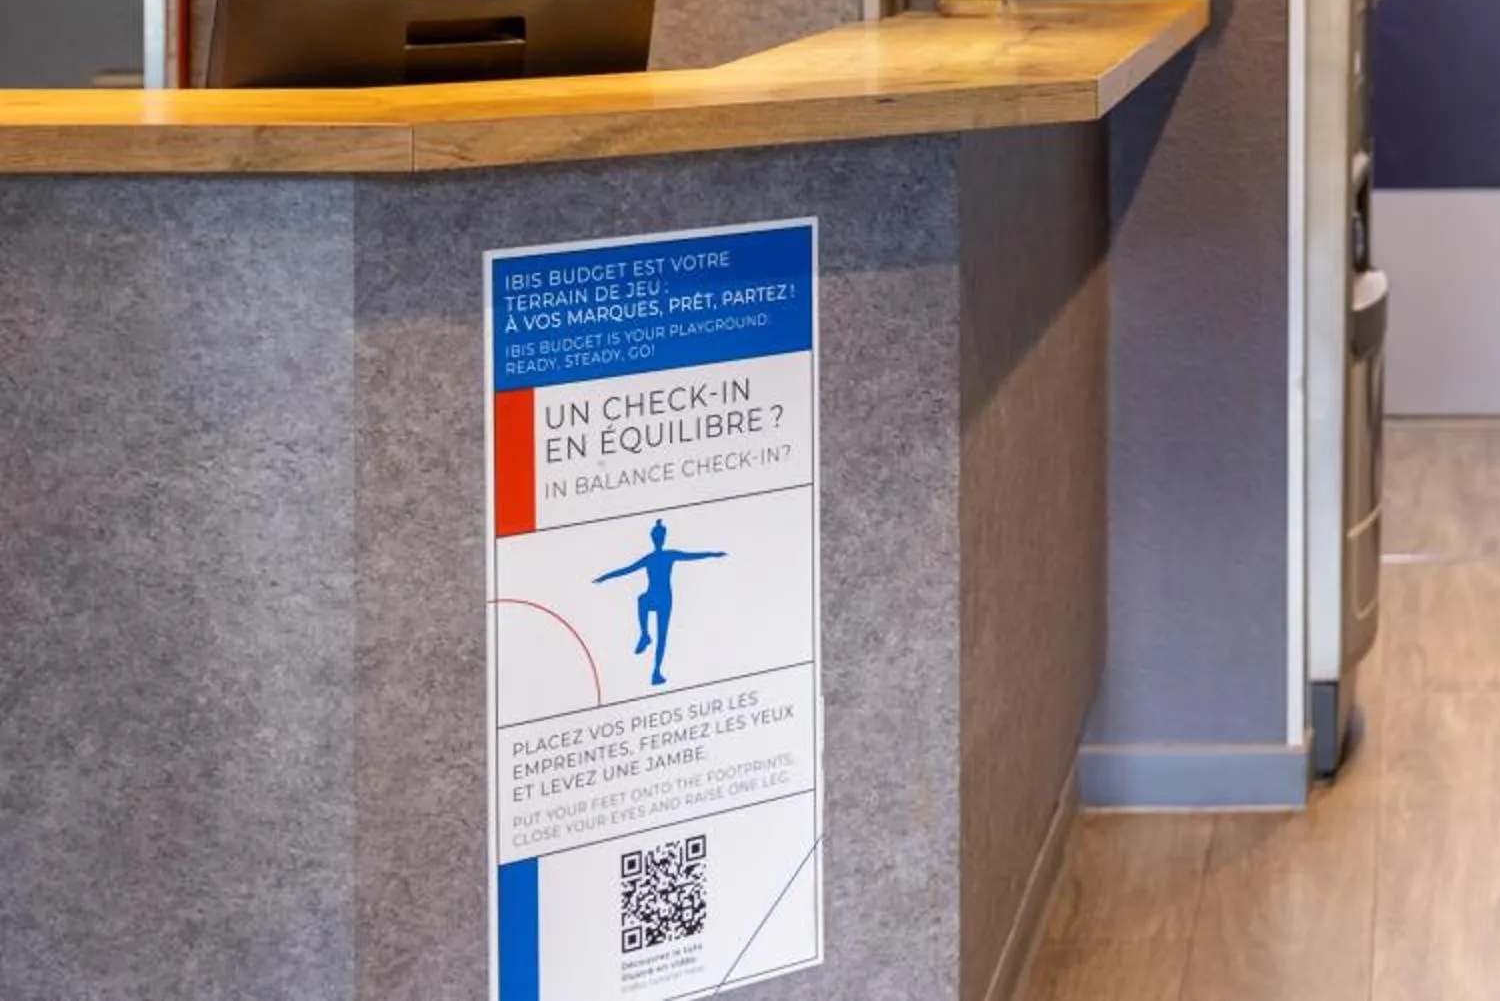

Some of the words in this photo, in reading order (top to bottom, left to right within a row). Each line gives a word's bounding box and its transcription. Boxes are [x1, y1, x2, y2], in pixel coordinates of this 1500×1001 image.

[505, 272, 542, 291] IBIS
[549, 262, 626, 286] BUDGET
[633, 258, 664, 277] EST
[671, 250, 730, 271] VOTRE
[504, 288, 588, 312] TERRAIN
[595, 284, 620, 301] DE
[505, 314, 519, 334] À
[523, 311, 562, 330] VOS
[567, 299, 663, 326] MARQUES,
[669, 290, 717, 313] PRÊT,
[505, 342, 536, 359] IBIS
[540, 334, 601, 354] BUDGET
[607, 331, 620, 345] IS
[624, 325, 666, 343] YOUR
[628, 343, 656, 359] GO!
[545, 399, 590, 430] UN
[602, 377, 751, 422] CHECK-IN
[546, 434, 587, 464] EN
[545, 481, 567, 500] IN
[575, 461, 675, 495] BALANCE
[681, 443, 793, 479] CHECK-IN?
[512, 728, 584, 758] PLACEZ
[588, 720, 625, 740] VOS
[631, 707, 683, 732] PIEDS
[687, 699, 723, 720] SUR
[728, 690, 759, 710] LES
[640, 722, 711, 751] FERMEZ
[715, 714, 748, 735] LES
[751, 704, 796, 727] YEUX
[512, 783, 535, 802] ET
[540, 769, 597, 796] LEVEZ
[602, 760, 641, 782] UNE
[512, 811, 542, 829] PUT
[546, 801, 588, 821] YOUR
[591, 792, 625, 810] FEET
[630, 781, 673, 802] ONTO
[677, 774, 703, 789] THE
[512, 825, 562, 848] CLOSE
[566, 815, 607, 833] YOUR
[610, 803, 647, 825] EYES
[649, 798, 682, 816] AND
[685, 784, 725, 805] RAISE
[728, 775, 760, 796] ONE
